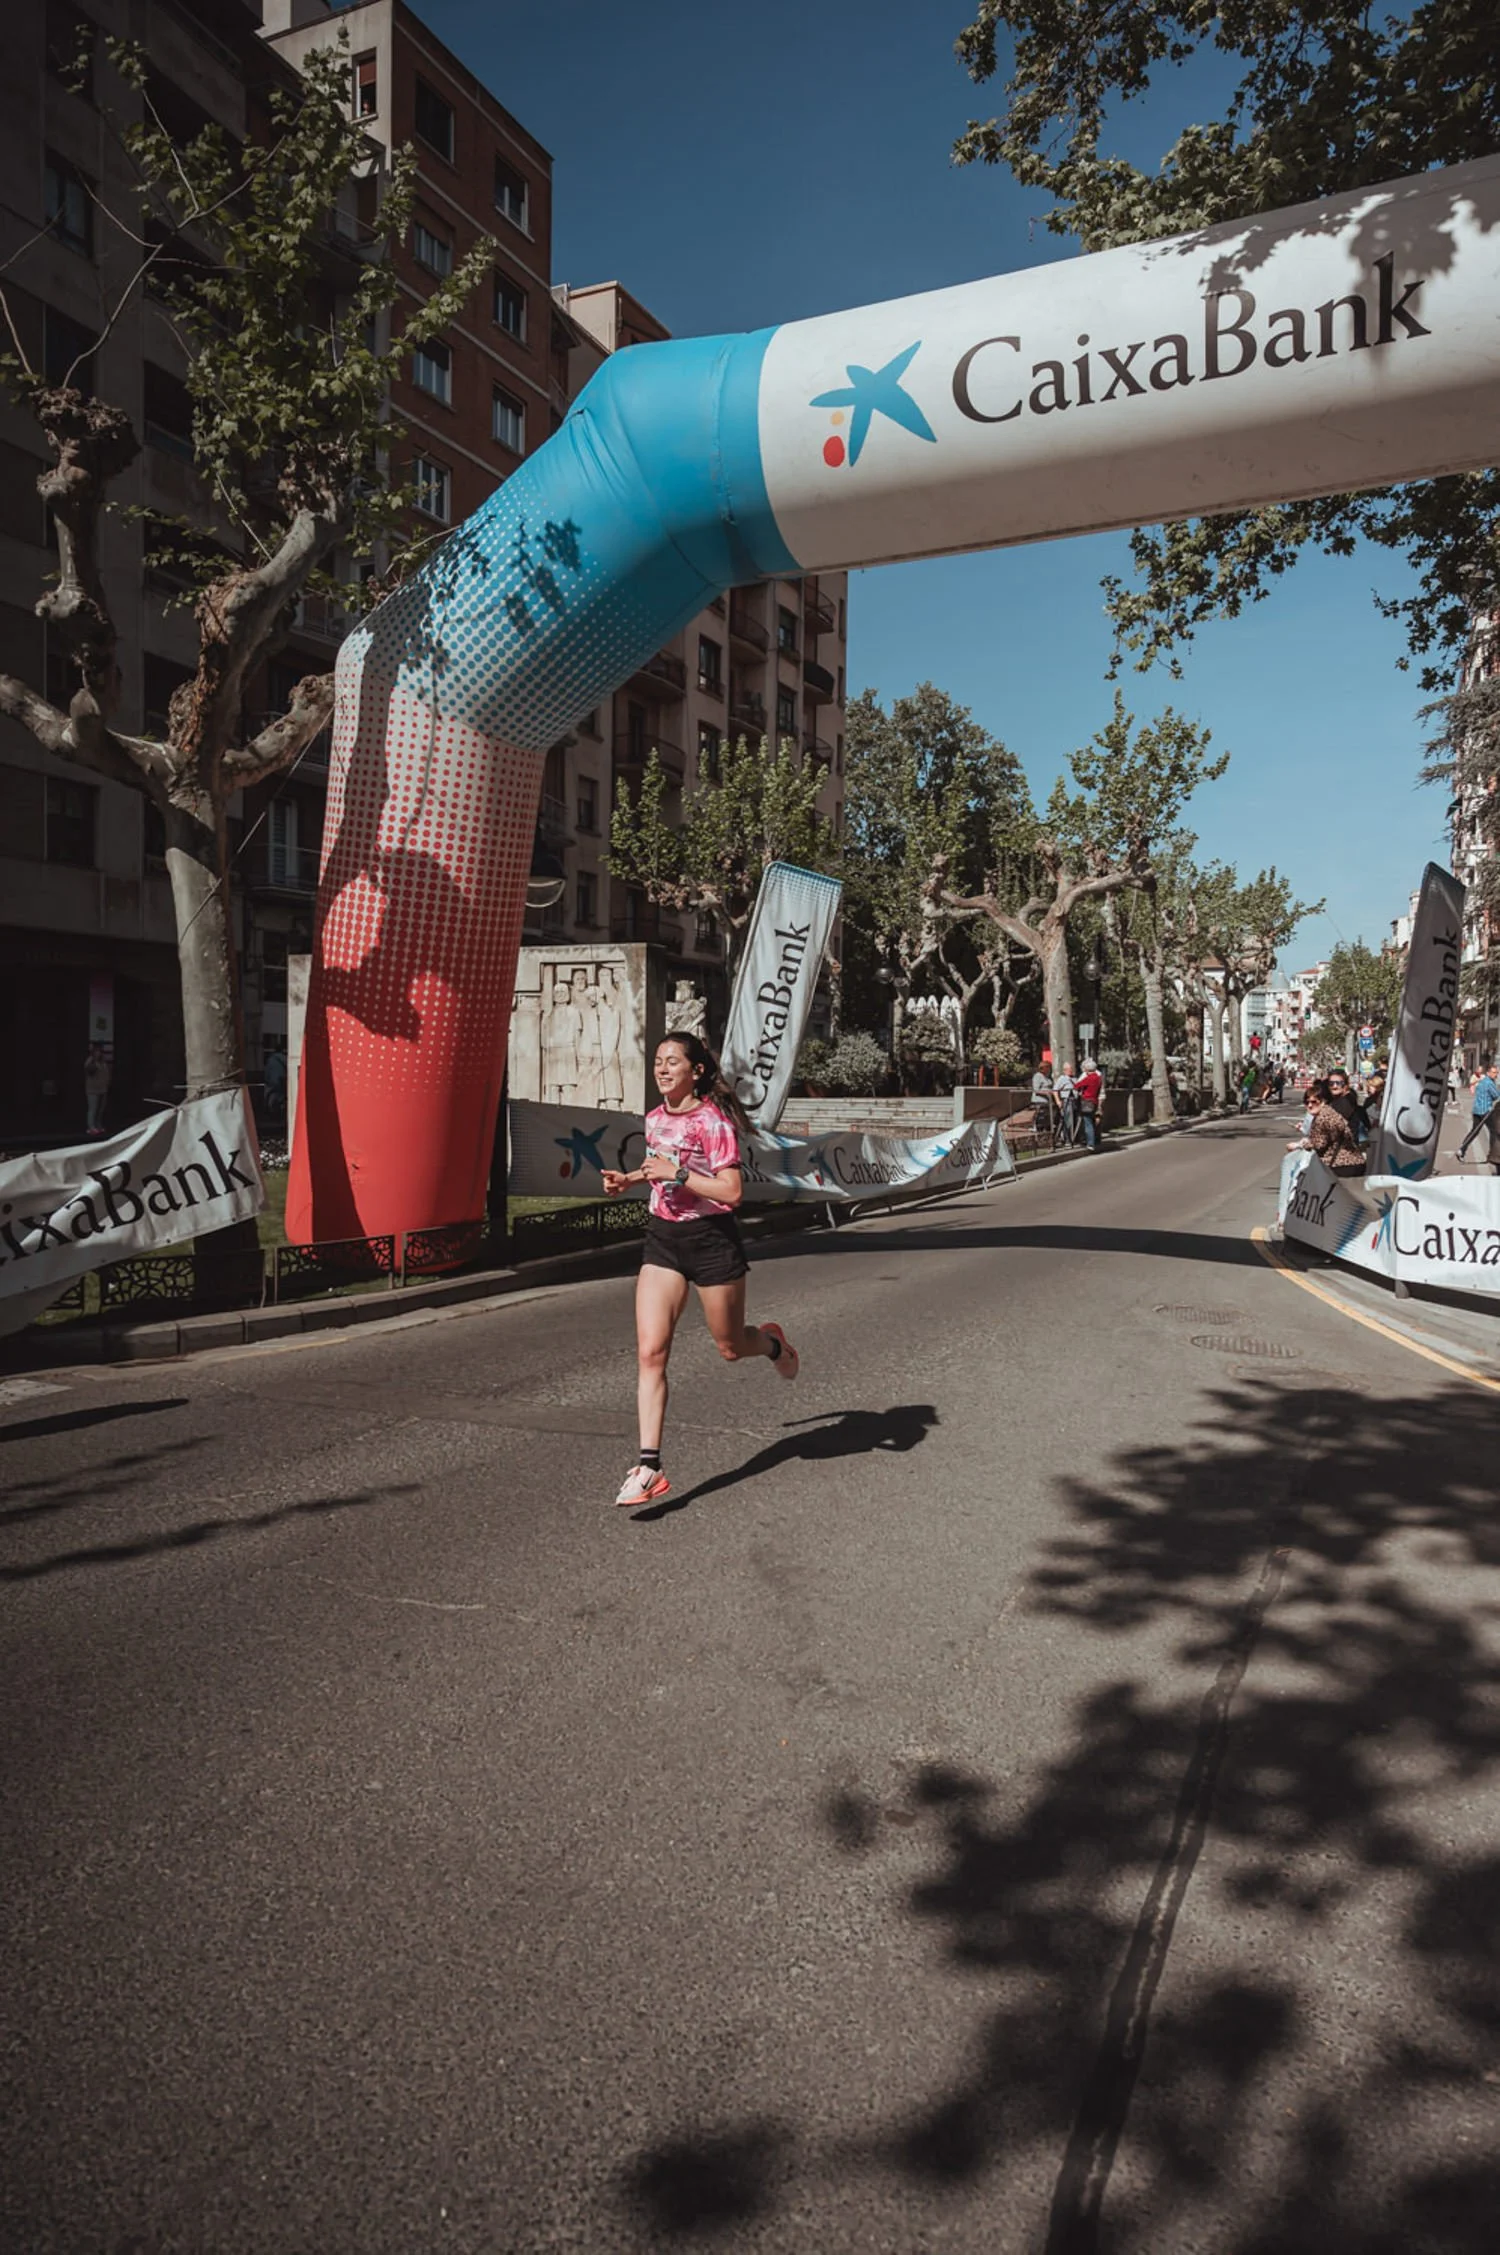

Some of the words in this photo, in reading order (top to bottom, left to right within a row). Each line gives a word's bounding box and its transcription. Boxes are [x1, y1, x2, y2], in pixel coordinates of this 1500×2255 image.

[951, 250, 1432, 423] CaixaBank
[734, 922, 811, 1111] CaixaBank
[1396, 926, 1458, 1145] CaixaBank
[0, 1131, 255, 1266] ixaBank
